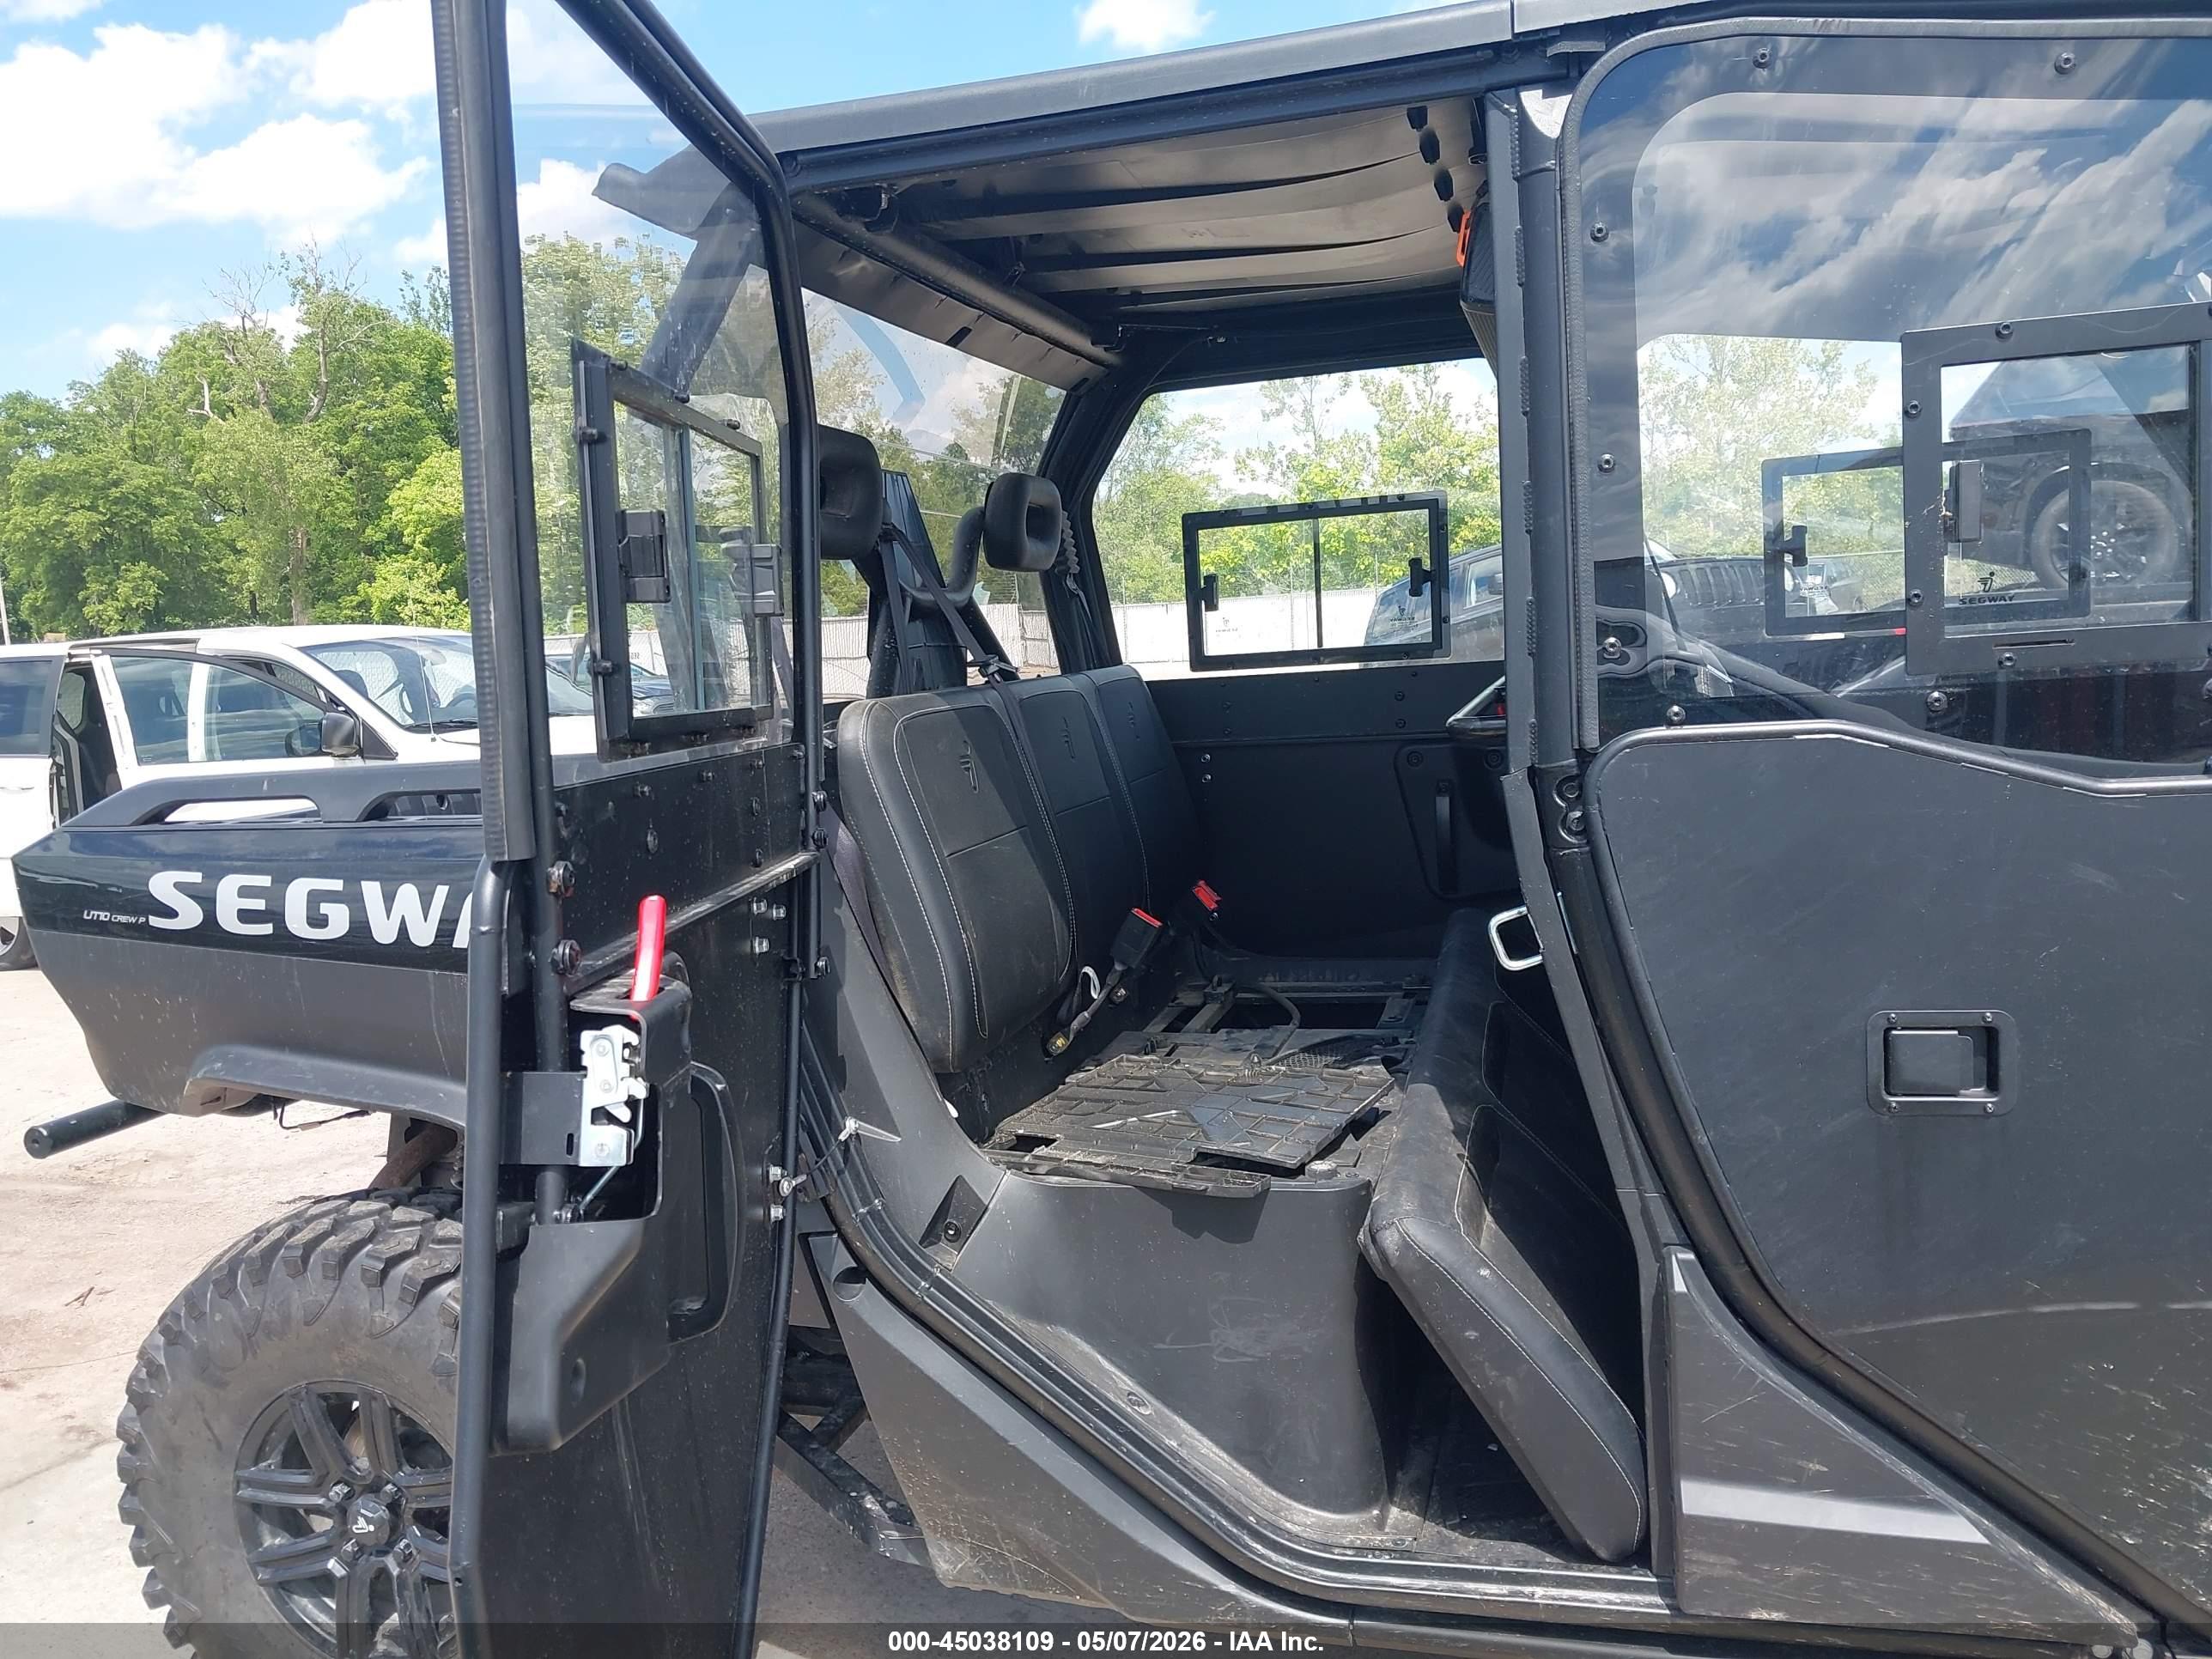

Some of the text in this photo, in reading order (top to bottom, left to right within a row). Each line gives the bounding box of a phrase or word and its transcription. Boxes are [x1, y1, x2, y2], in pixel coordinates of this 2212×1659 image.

[1958, 594, 2015, 605] SEGWAY
[111, 915, 138, 924] CREW
[138, 916, 146, 925] P
